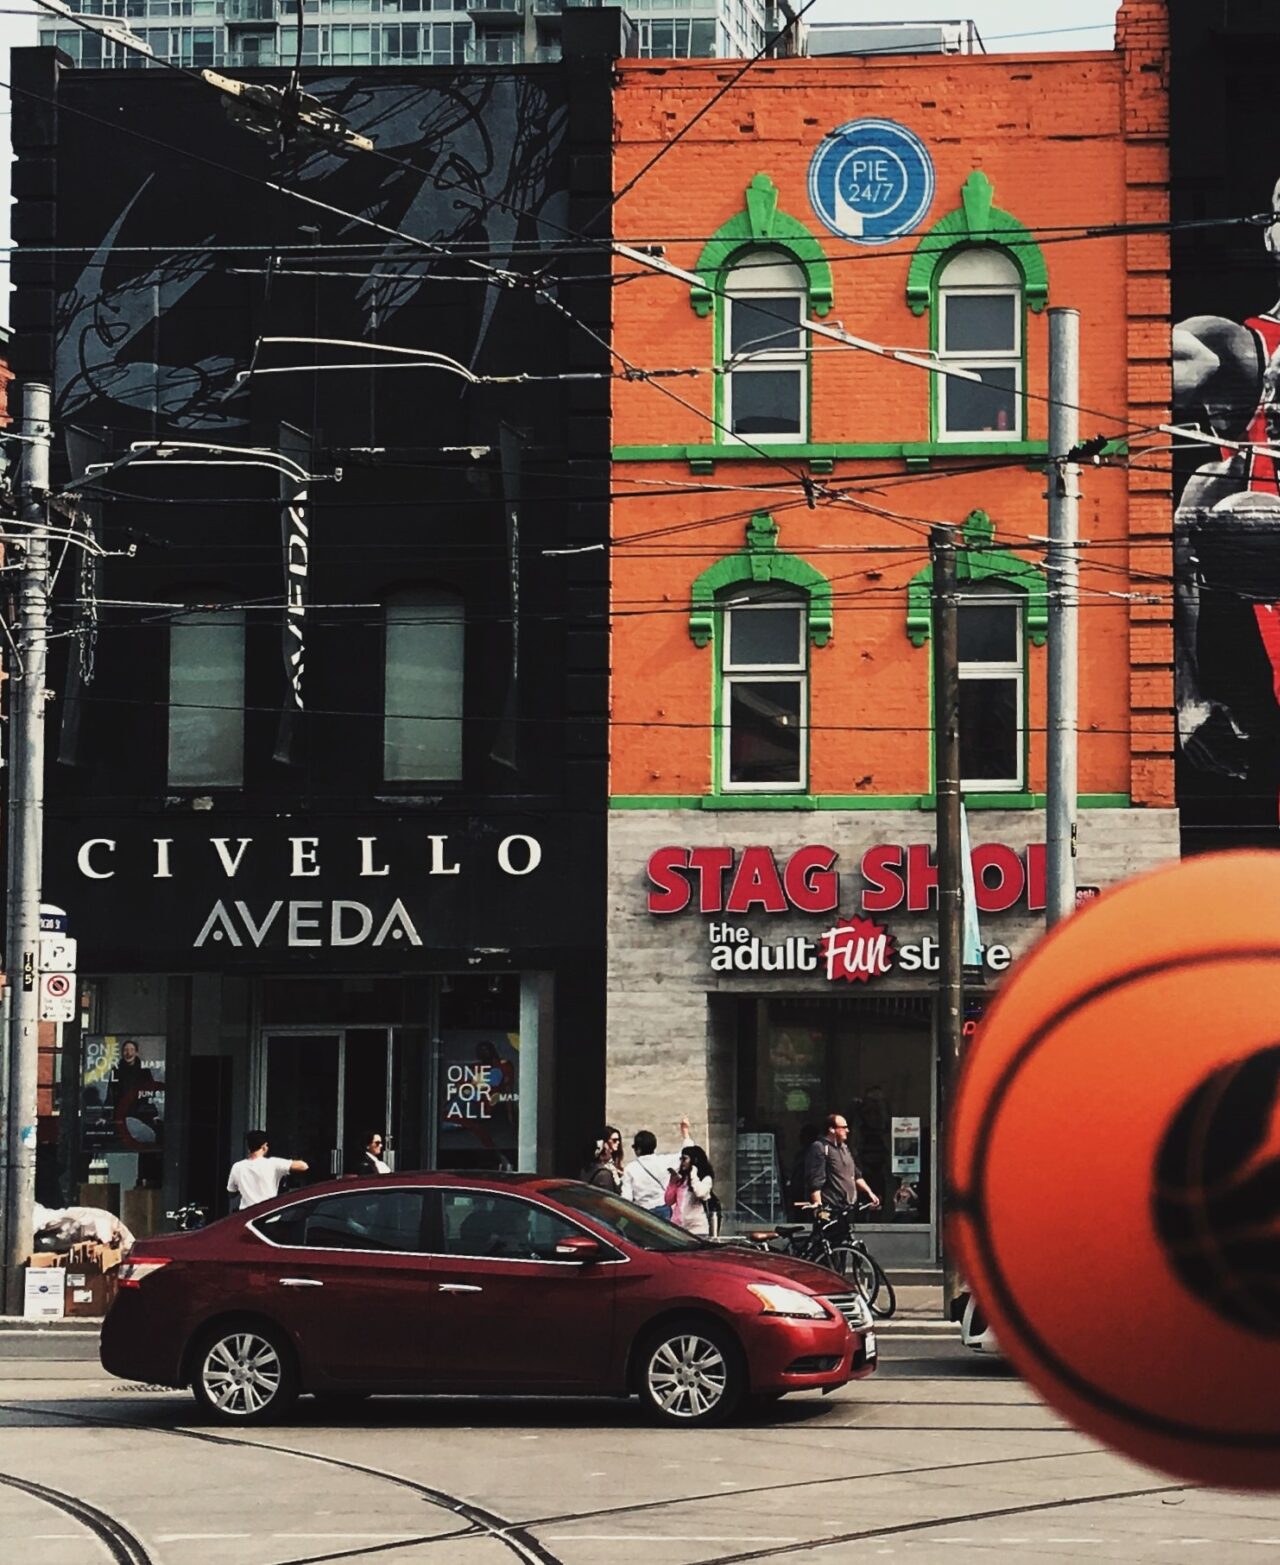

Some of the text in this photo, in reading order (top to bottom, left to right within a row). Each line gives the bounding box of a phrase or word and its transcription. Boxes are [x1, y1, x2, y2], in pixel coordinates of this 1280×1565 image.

[852, 160, 888, 183] PIE
[847, 183, 895, 205] 24/7
[77, 834, 543, 879] CIVELLO
[646, 844, 840, 914] STAG
[193, 899, 424, 948] AVEDA
[709, 922, 750, 944] the
[710, 926, 1012, 980] adult Fun ste
[87, 1043, 120, 1056] ONE
[86, 1056, 119, 1070] FOR
[447, 1065, 492, 1082] ONE
[87, 1071, 119, 1083] ALL
[446, 1083, 492, 1102] FOR
[446, 1102, 492, 1118] ALL
